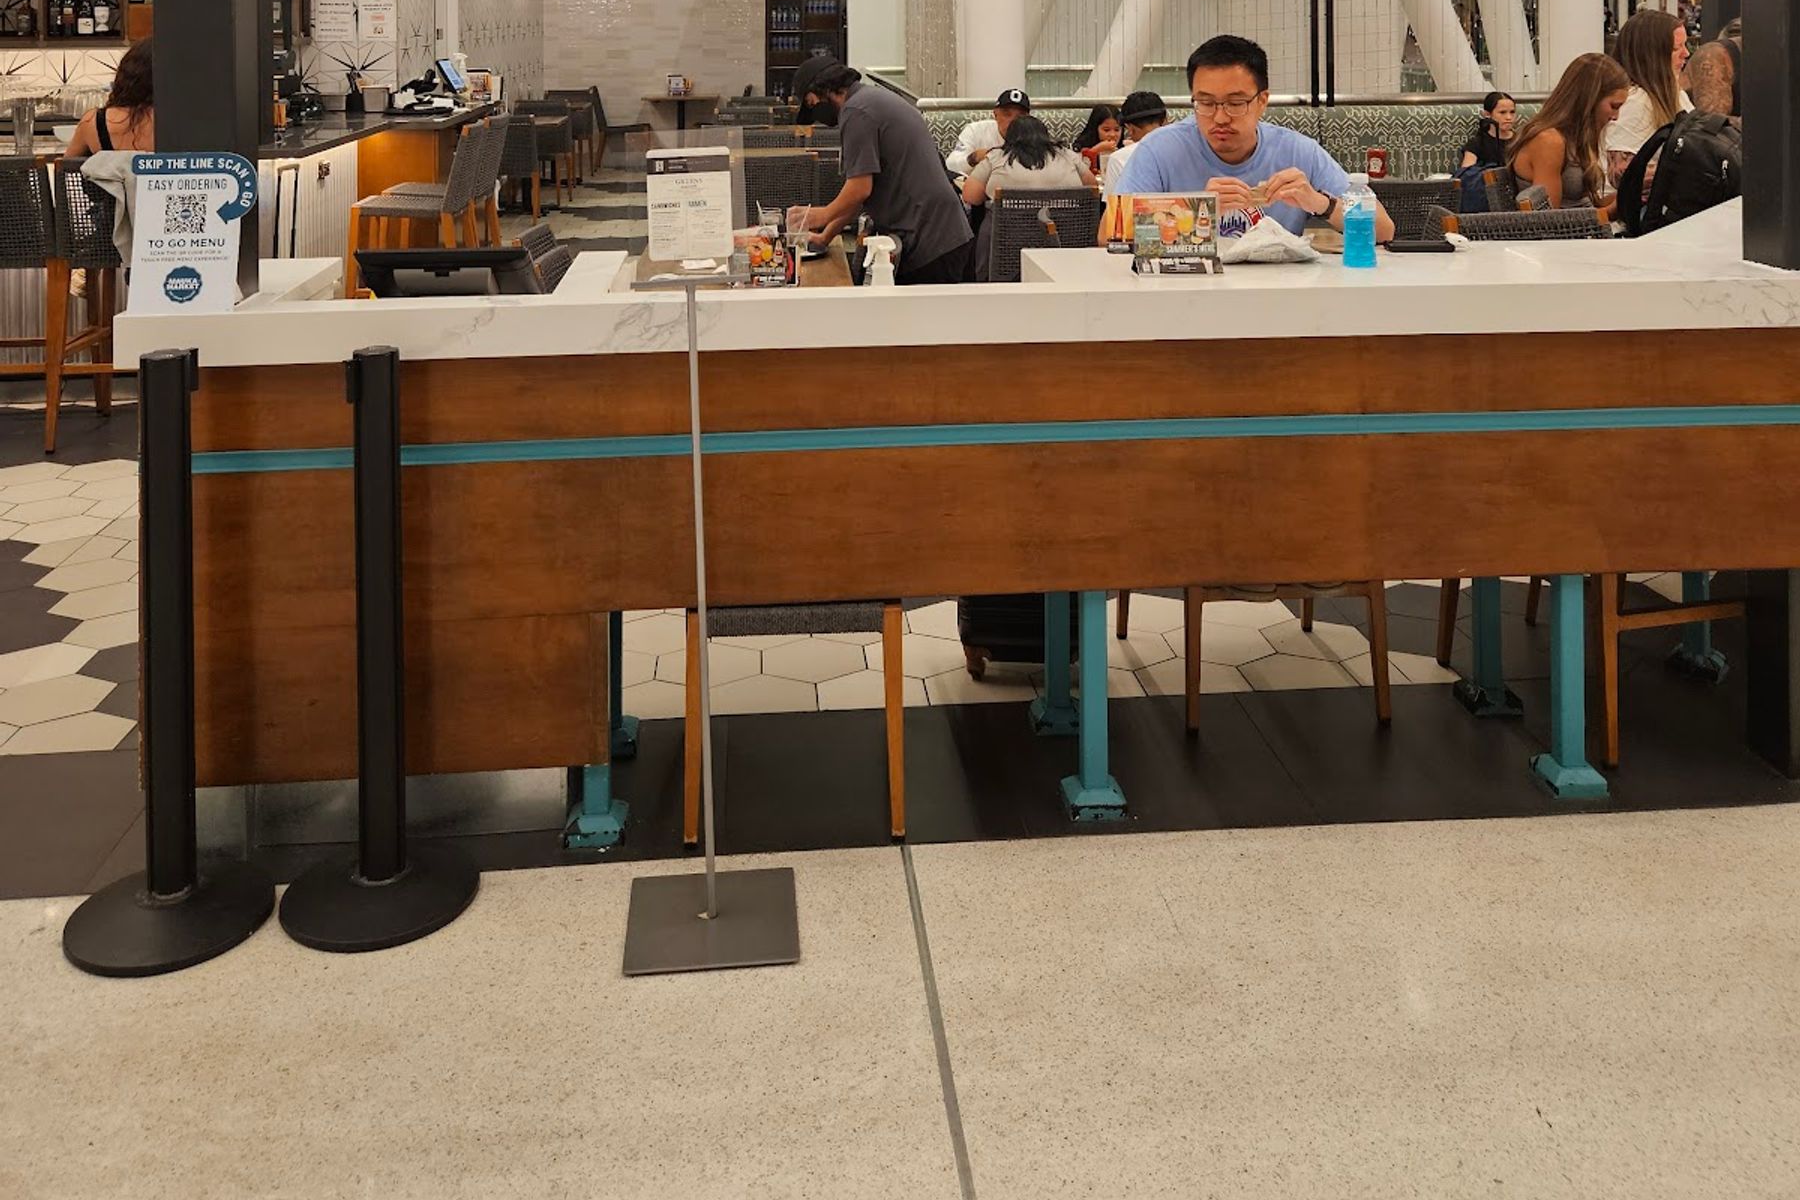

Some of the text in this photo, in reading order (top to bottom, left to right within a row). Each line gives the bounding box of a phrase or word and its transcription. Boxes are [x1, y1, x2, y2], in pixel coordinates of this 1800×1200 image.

[138, 157, 253, 207] SKIP THE LINE SCAN GO
[147, 178, 228, 191] EASY ORDERING
[148, 238, 225, 249] TO GO MENU
